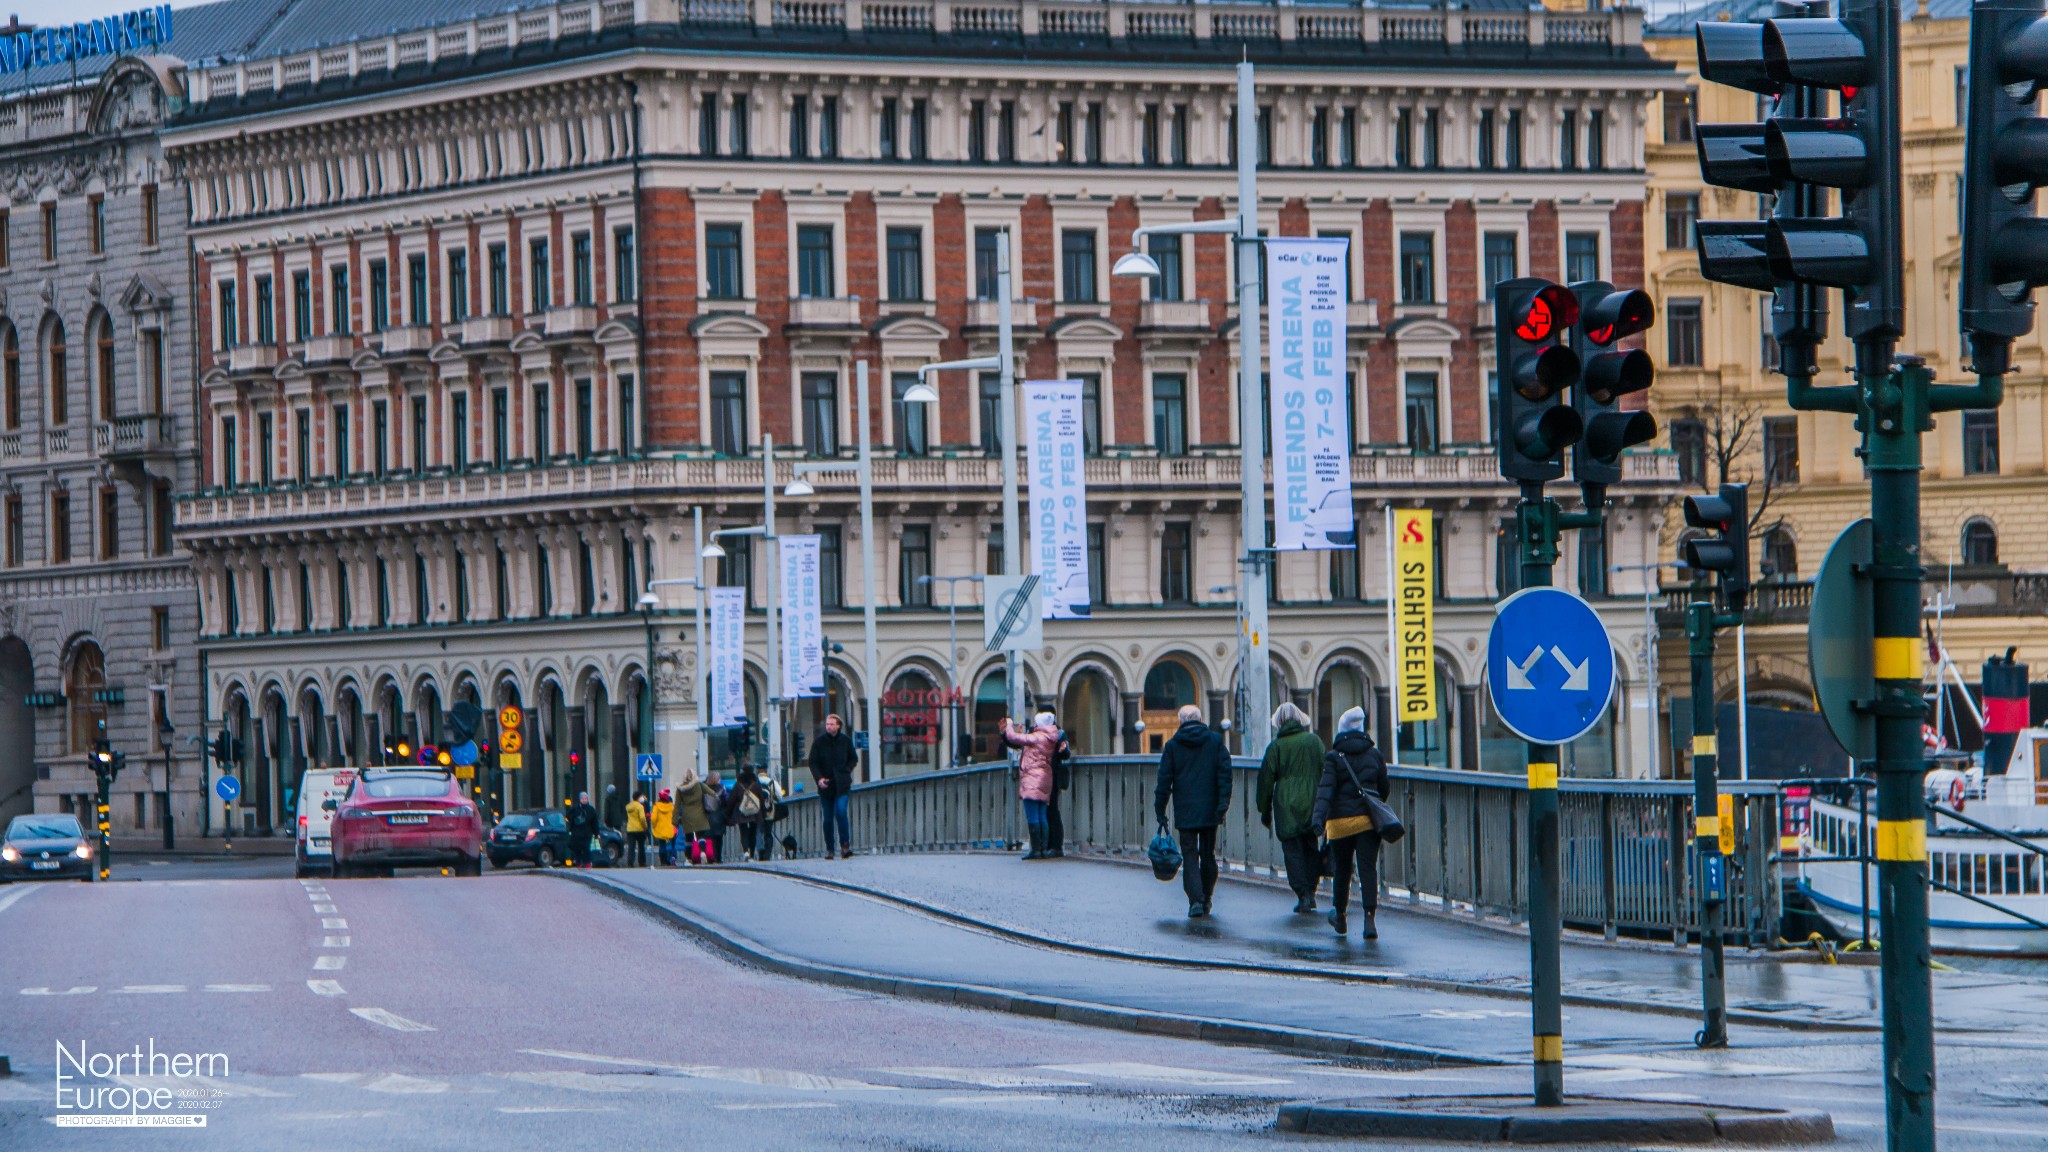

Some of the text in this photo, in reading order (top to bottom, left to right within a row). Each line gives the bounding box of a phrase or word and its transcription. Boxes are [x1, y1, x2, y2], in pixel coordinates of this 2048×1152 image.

[1278, 254, 1338, 264] eCar Expo
[1313, 319, 1333, 376] FEB
[1281, 275, 1308, 522] FRIENDS ARENA
[1060, 442, 1076, 487] FEB
[1036, 410, 1057, 597] FRIENDS ARENA
[787, 556, 798, 609] ARENA
[803, 576, 814, 607] FEB
[788, 614, 800, 683] FRIENDS
[1403, 562, 1429, 713] SIGHTSEEING
[504, 711, 518, 723] 30
